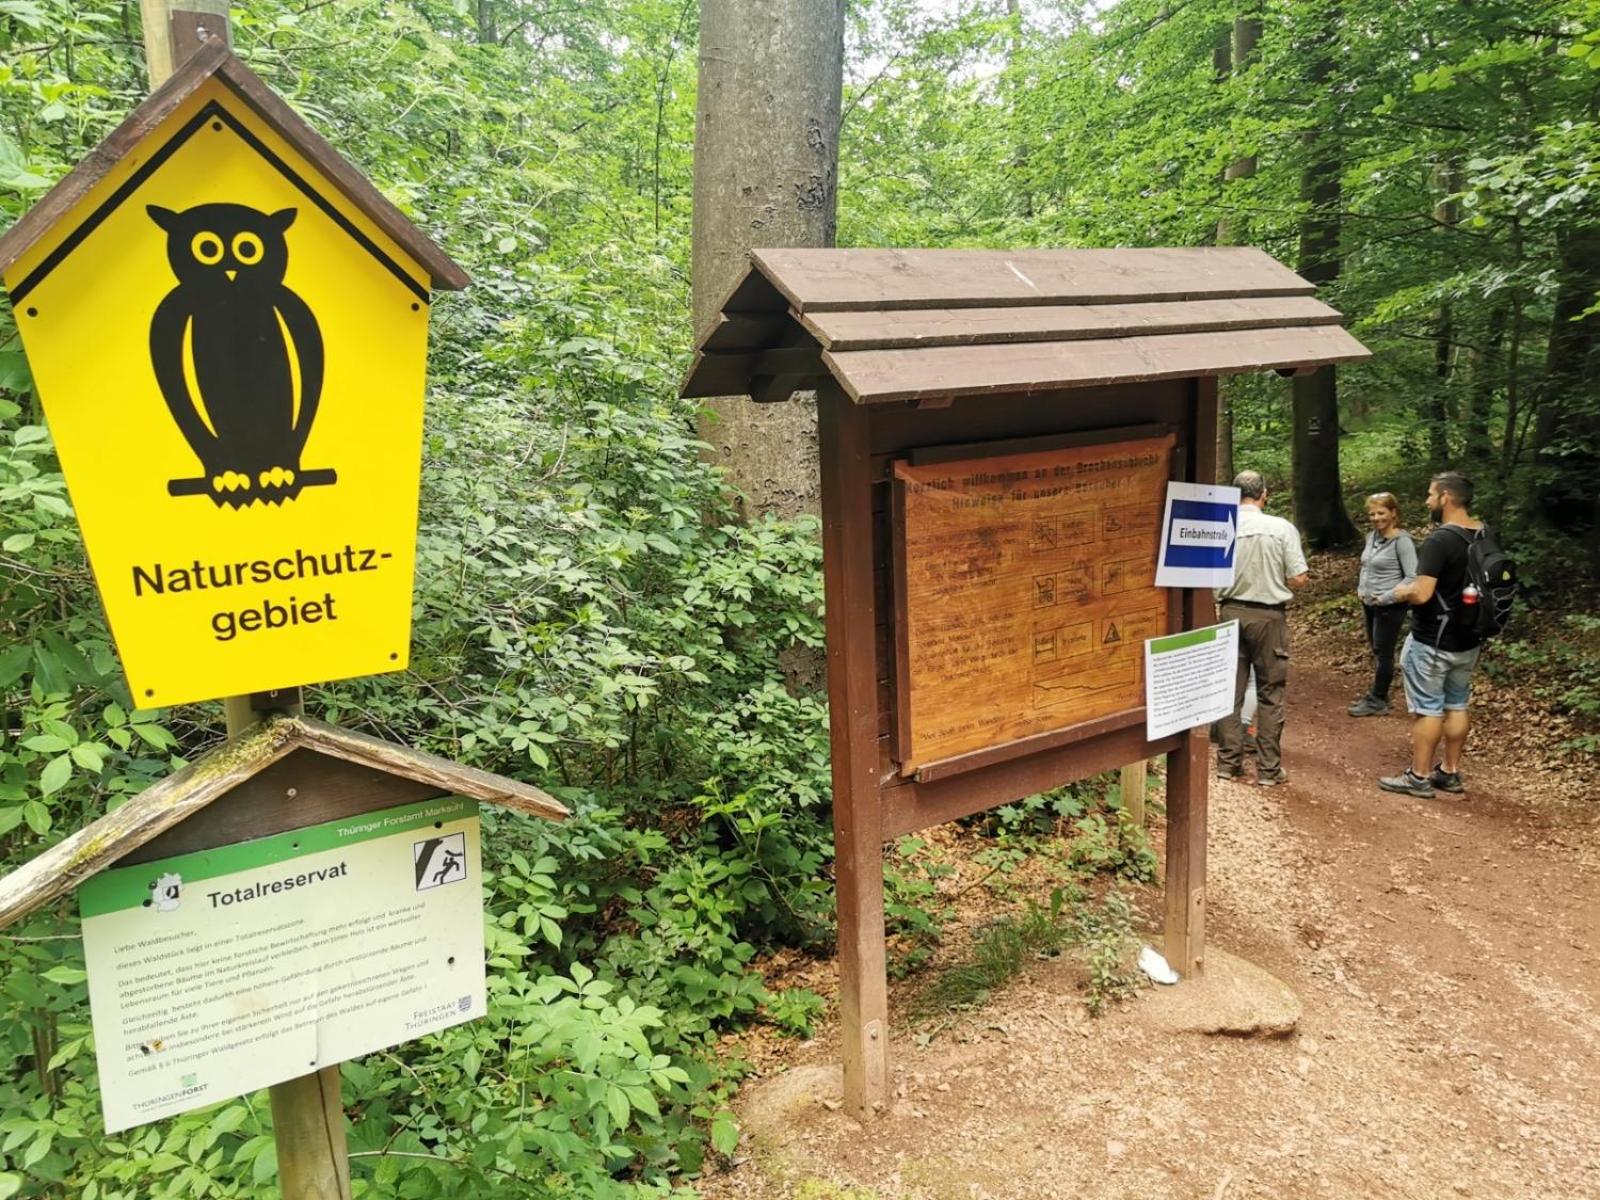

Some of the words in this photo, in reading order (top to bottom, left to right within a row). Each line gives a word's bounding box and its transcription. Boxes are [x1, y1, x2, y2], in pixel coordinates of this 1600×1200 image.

[1180, 527, 1228, 541] Einbahnstraße
[132, 545, 393, 596] Naturschutz-
[211, 593, 337, 642] gebiet
[337, 820, 381, 838] Thüringer
[384, 812, 424, 827] Forstamt
[207, 862, 348, 909] Totalreservat
